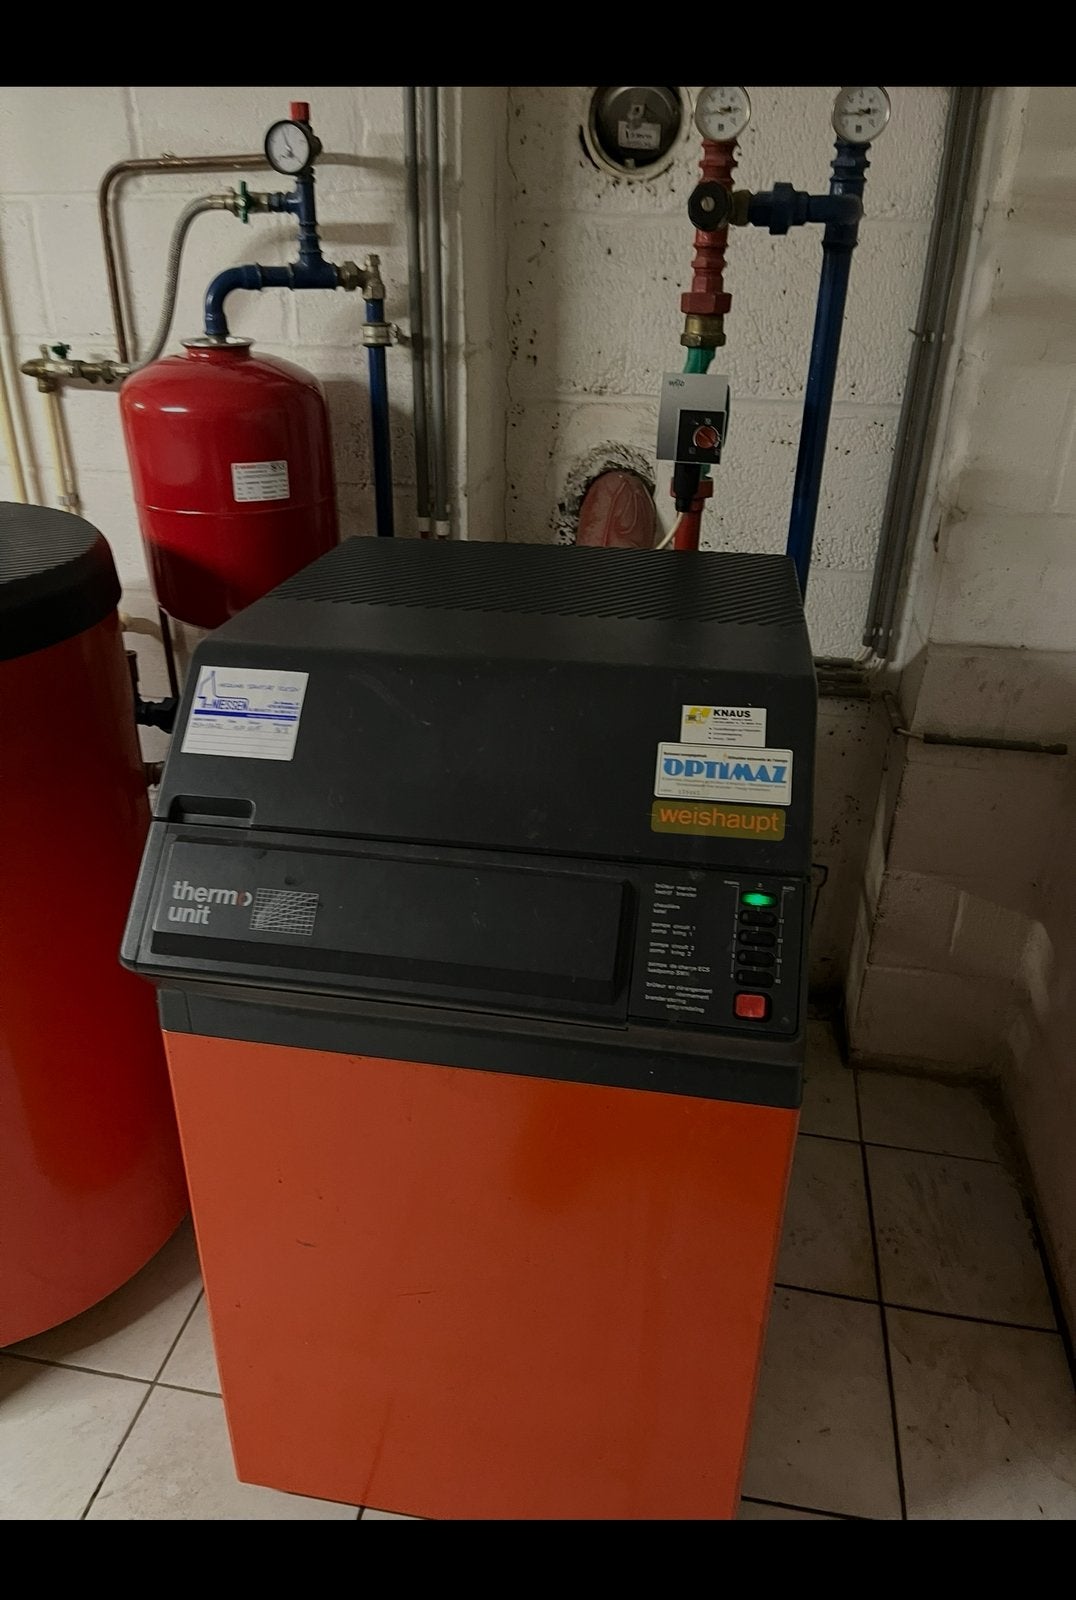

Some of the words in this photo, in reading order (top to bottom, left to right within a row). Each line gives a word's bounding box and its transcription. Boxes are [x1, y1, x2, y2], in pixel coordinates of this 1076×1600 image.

[713, 709, 751, 718] KNAUS
[663, 757, 787, 784] OPTIMAZ
[659, 806, 780, 833] weishaupt
[172, 880, 253, 907] thermo
[168, 904, 211, 924] unit
